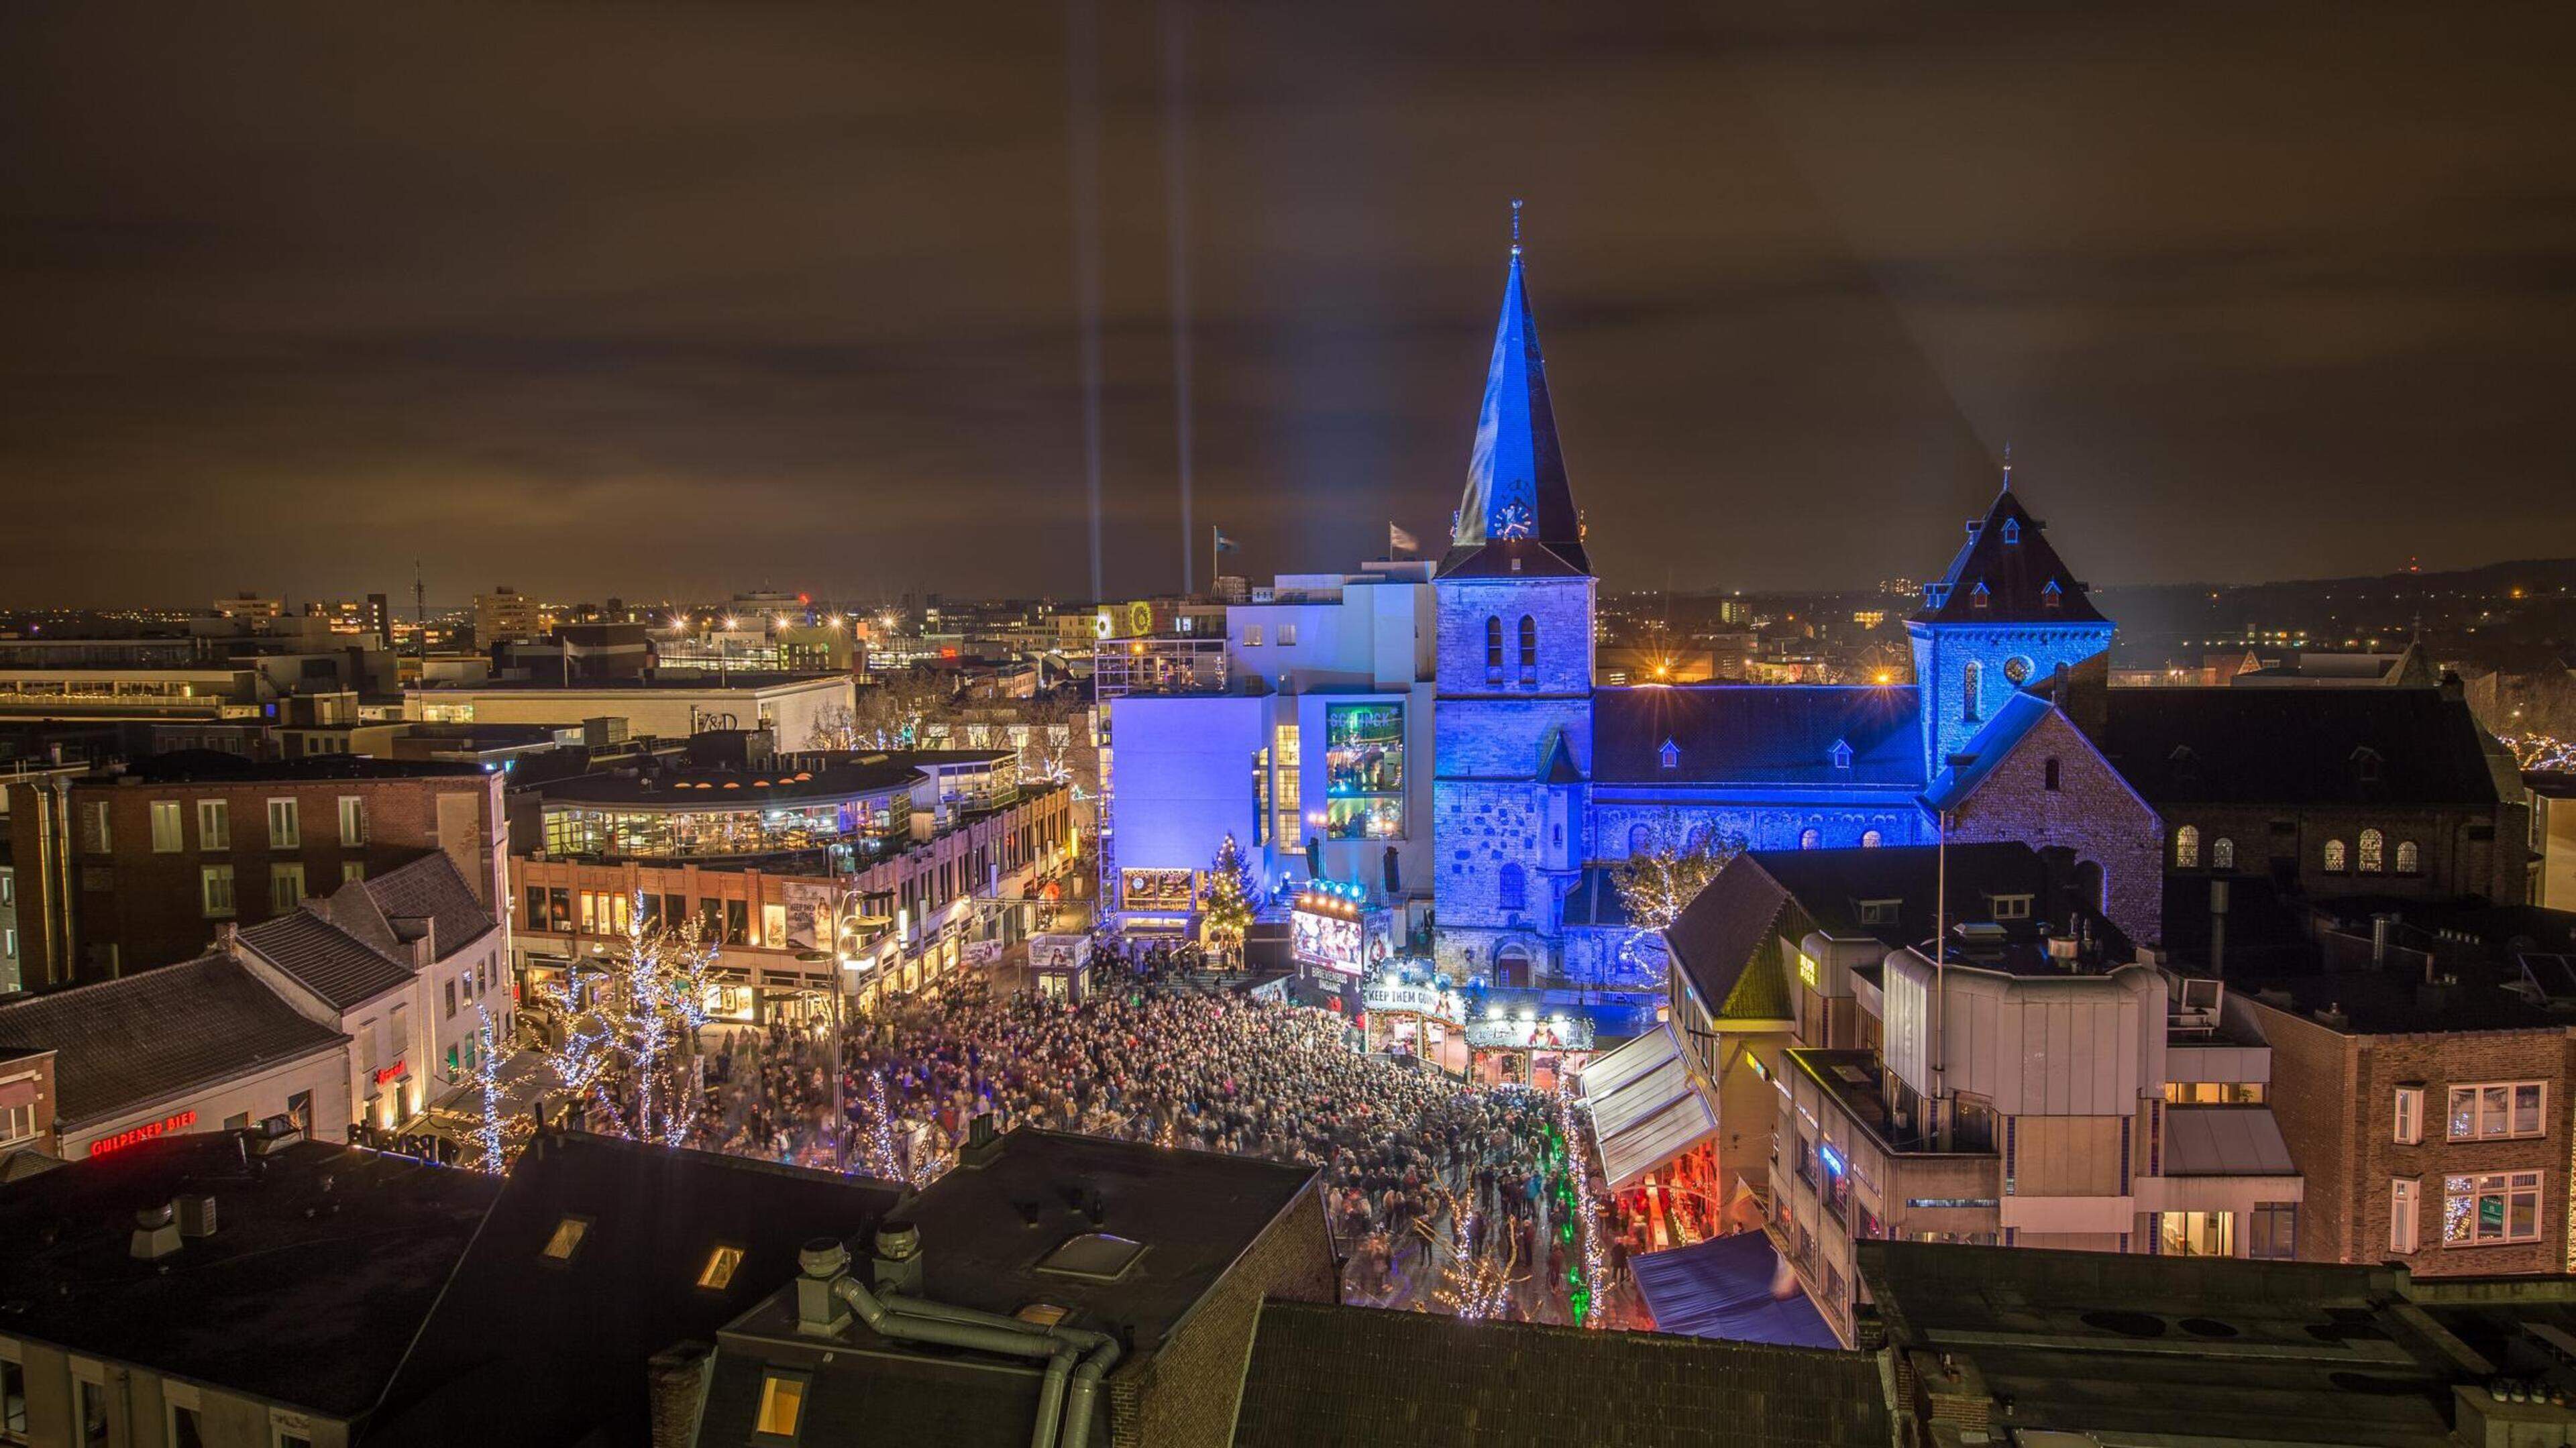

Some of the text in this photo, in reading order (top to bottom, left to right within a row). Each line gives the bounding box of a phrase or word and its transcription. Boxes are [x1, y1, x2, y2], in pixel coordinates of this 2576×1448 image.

[1368, 990, 1389, 1001] KEEP
[1392, 991, 1415, 1003] THEM
[91, 1109, 197, 1155] GULPENER BIER
